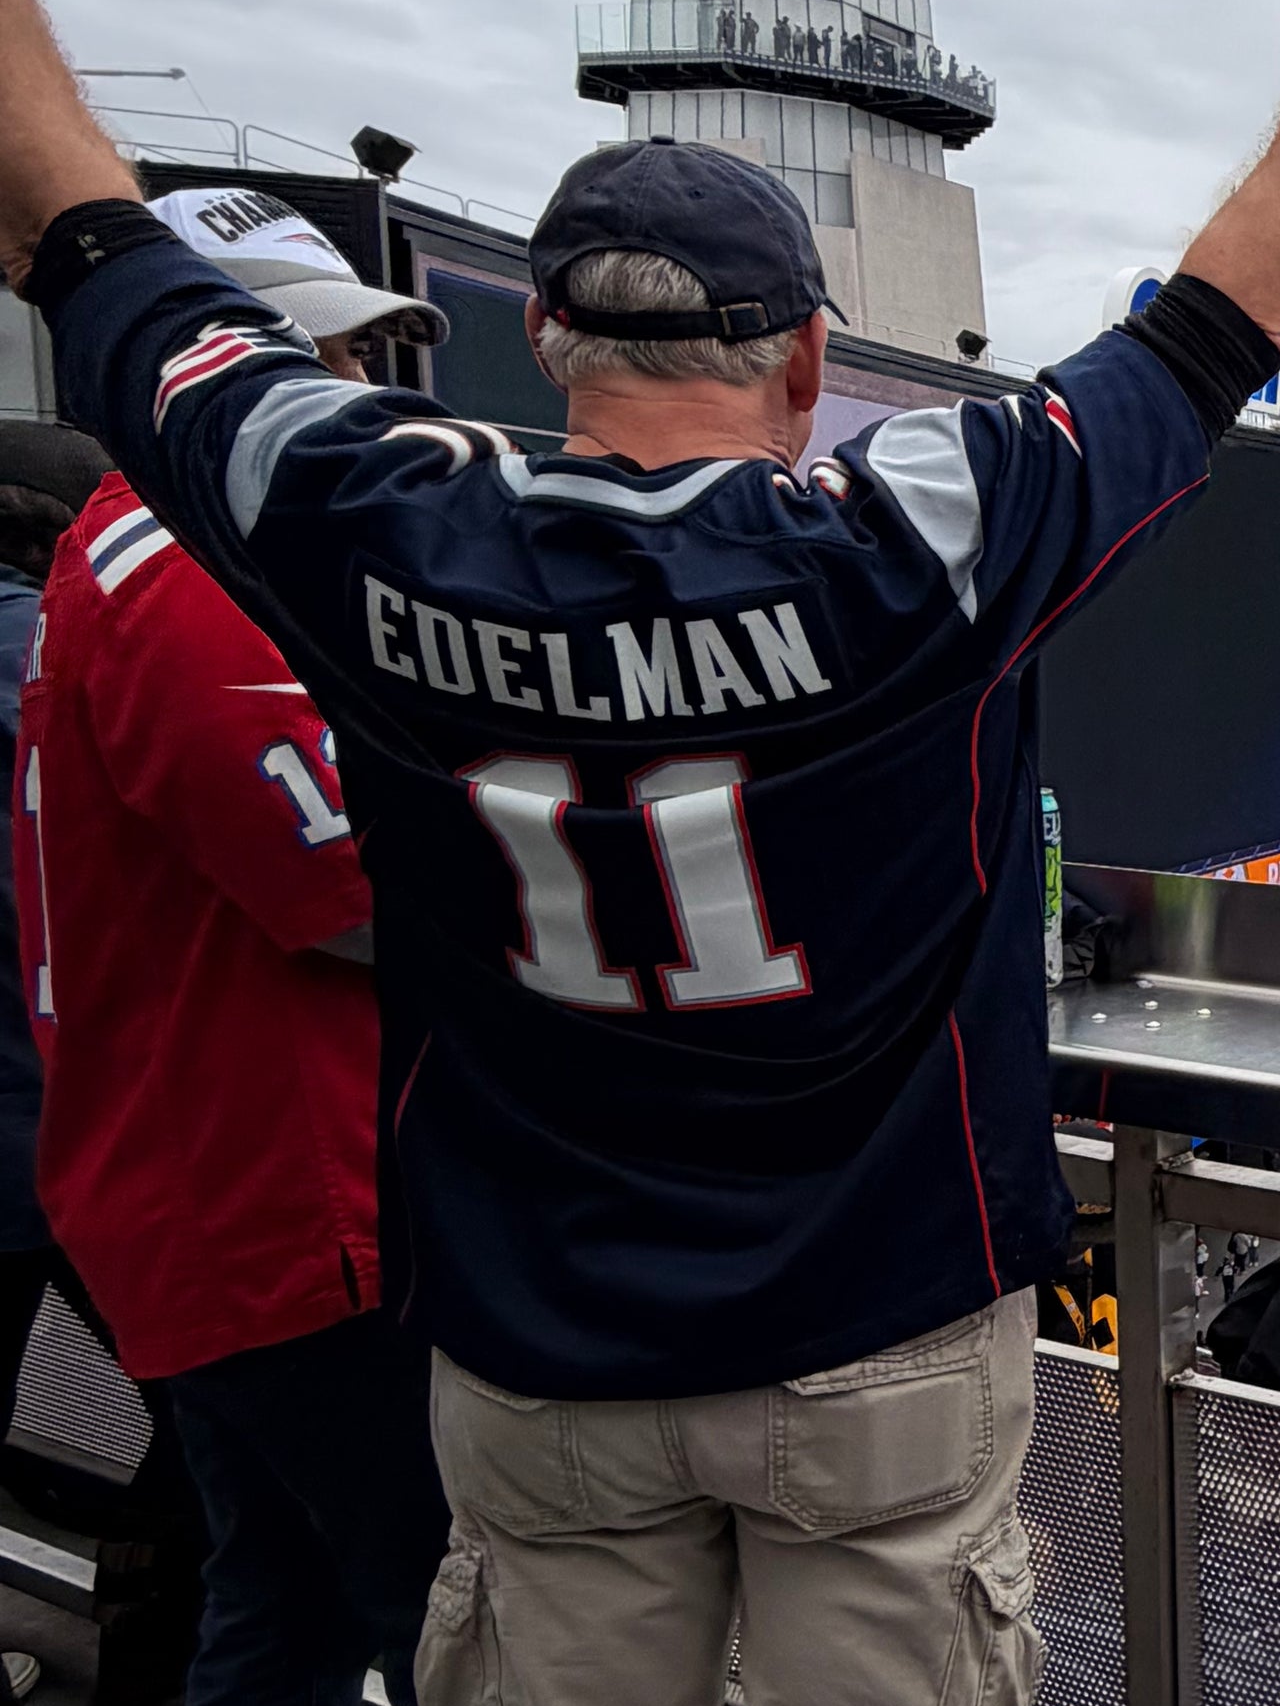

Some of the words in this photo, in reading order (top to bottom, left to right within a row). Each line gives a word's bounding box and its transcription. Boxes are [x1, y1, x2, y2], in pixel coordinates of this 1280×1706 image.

[364, 574, 833, 722] EDELMAN
[257, 728, 351, 849] 1
[454, 749, 814, 1013] 11
